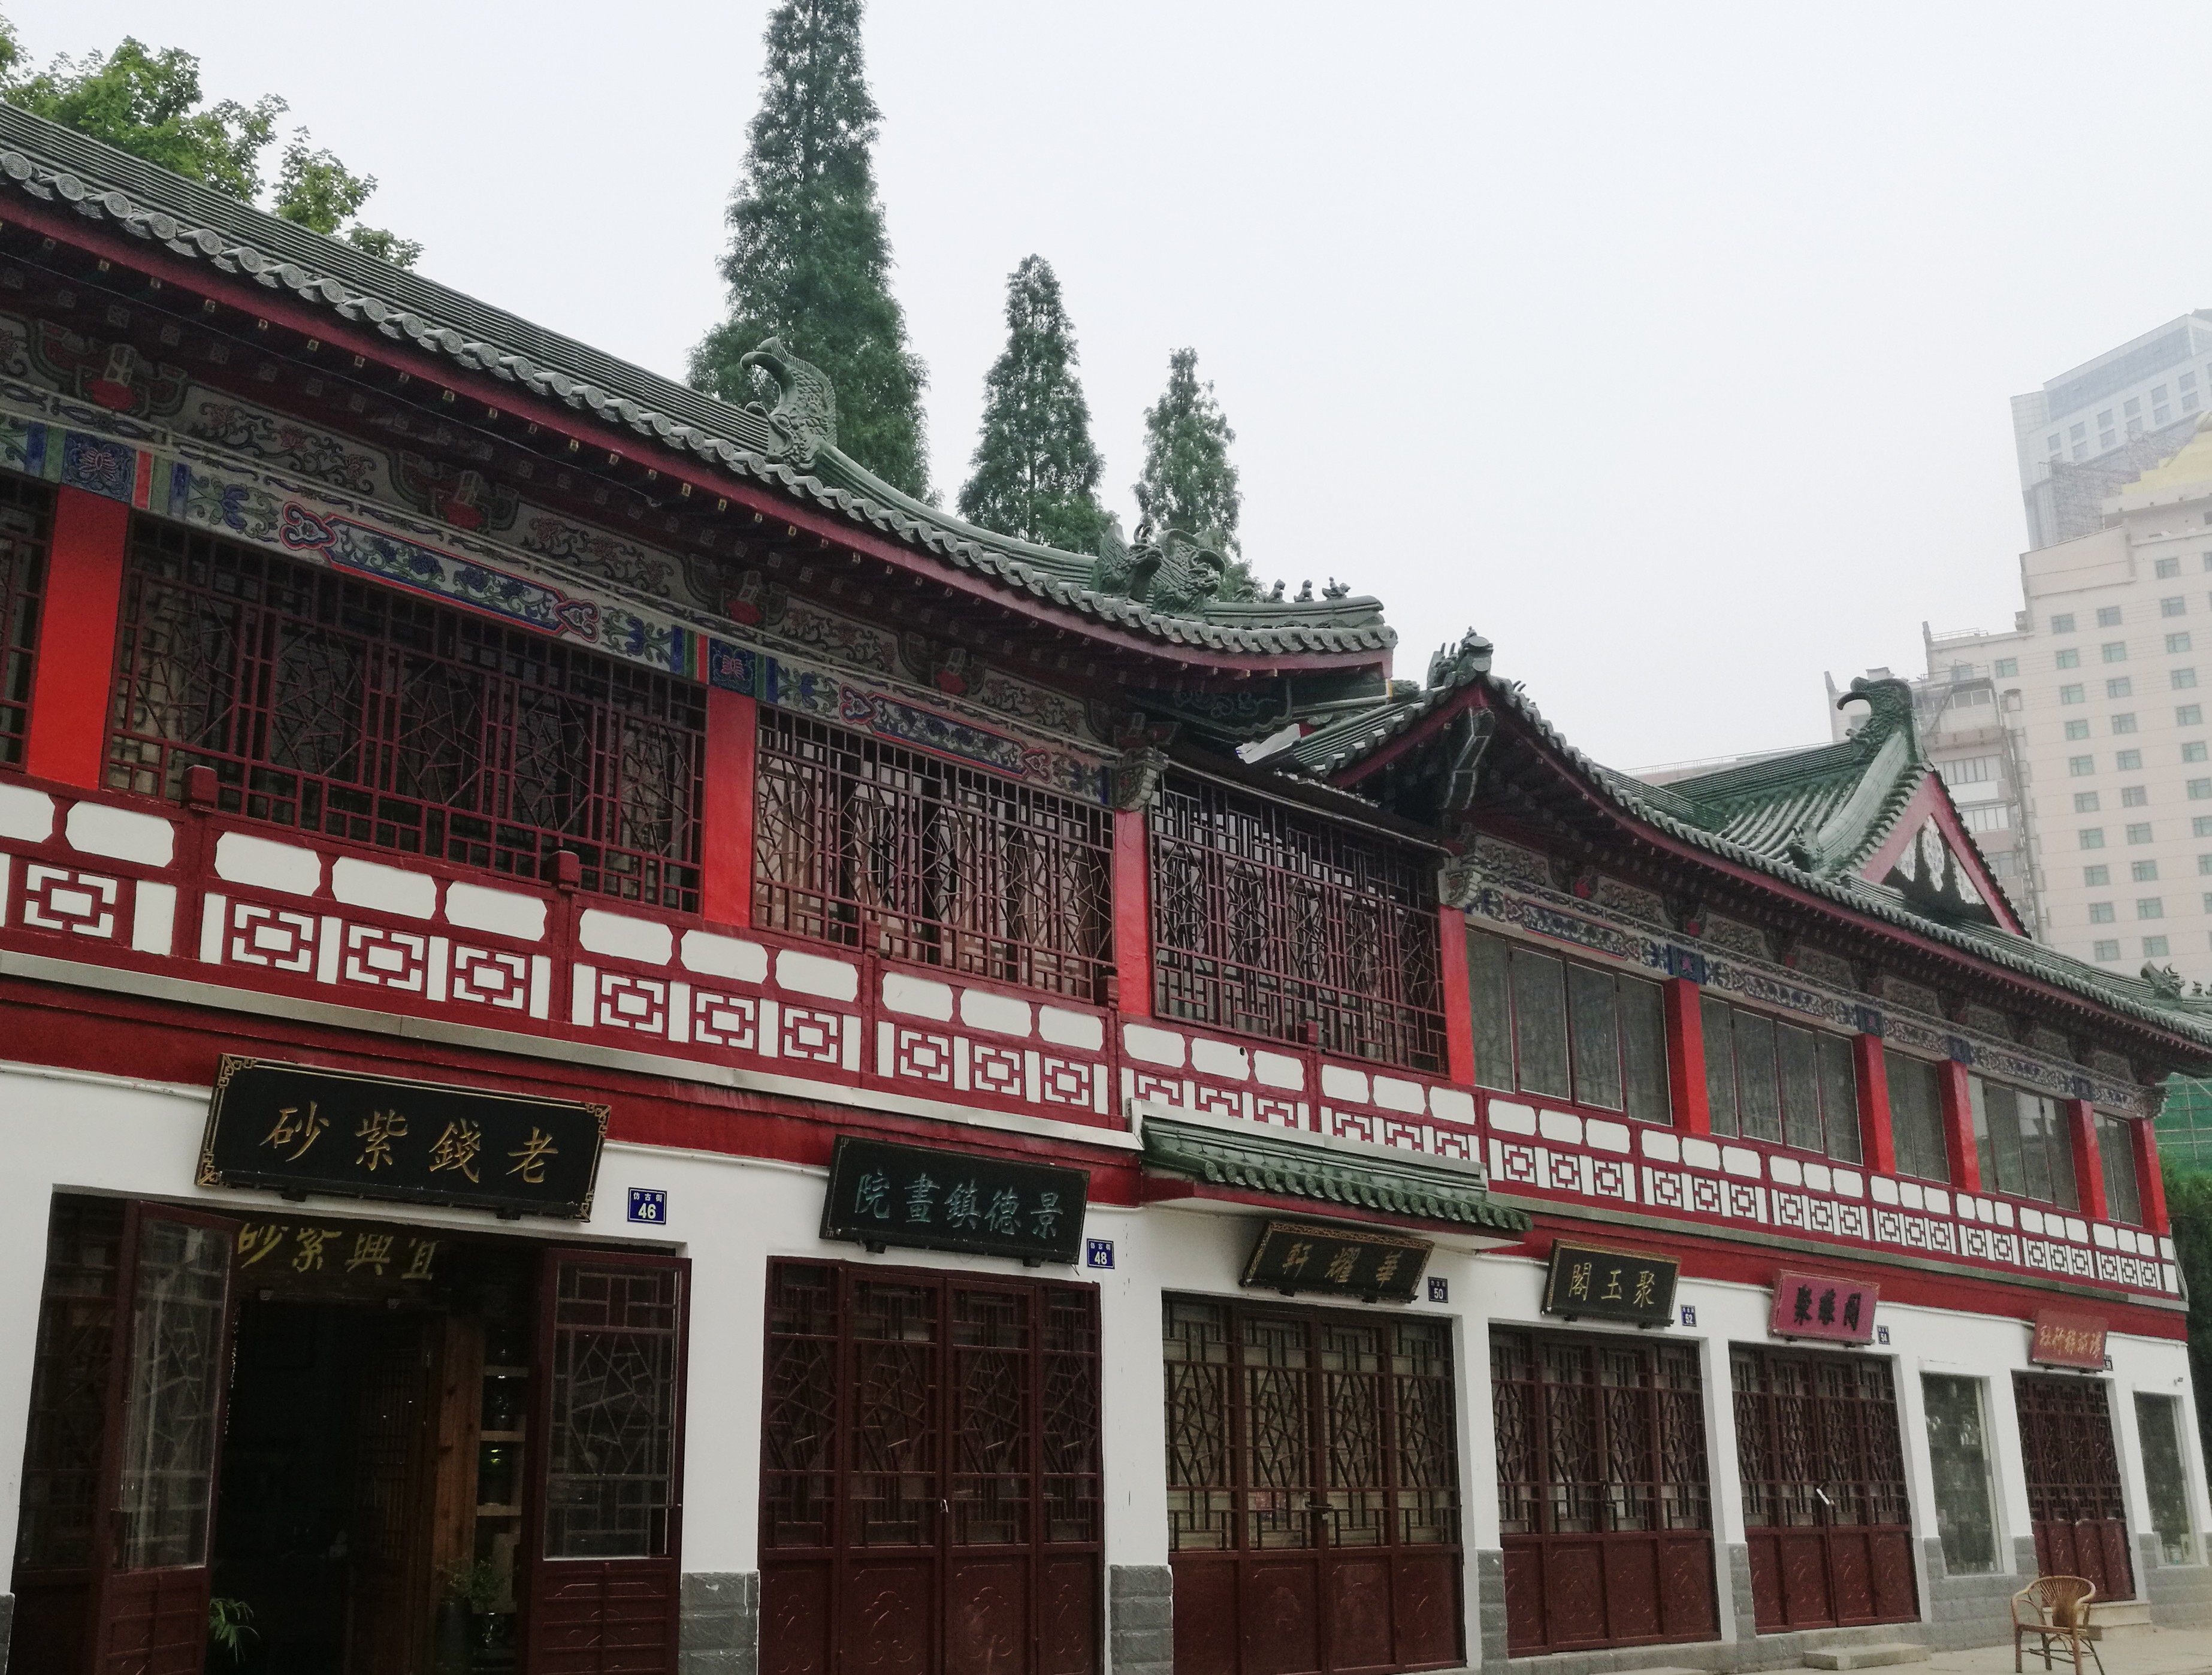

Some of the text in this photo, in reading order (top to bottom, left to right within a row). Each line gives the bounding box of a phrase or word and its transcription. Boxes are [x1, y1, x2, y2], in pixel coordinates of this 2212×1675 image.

[633, 1192, 663, 1202] 仿古街
[638, 1202, 656, 1219] 46
[1094, 1251, 1107, 1265] 48
[1434, 1287, 1443, 1299] 50
[1685, 1313, 1693, 1324] 52
